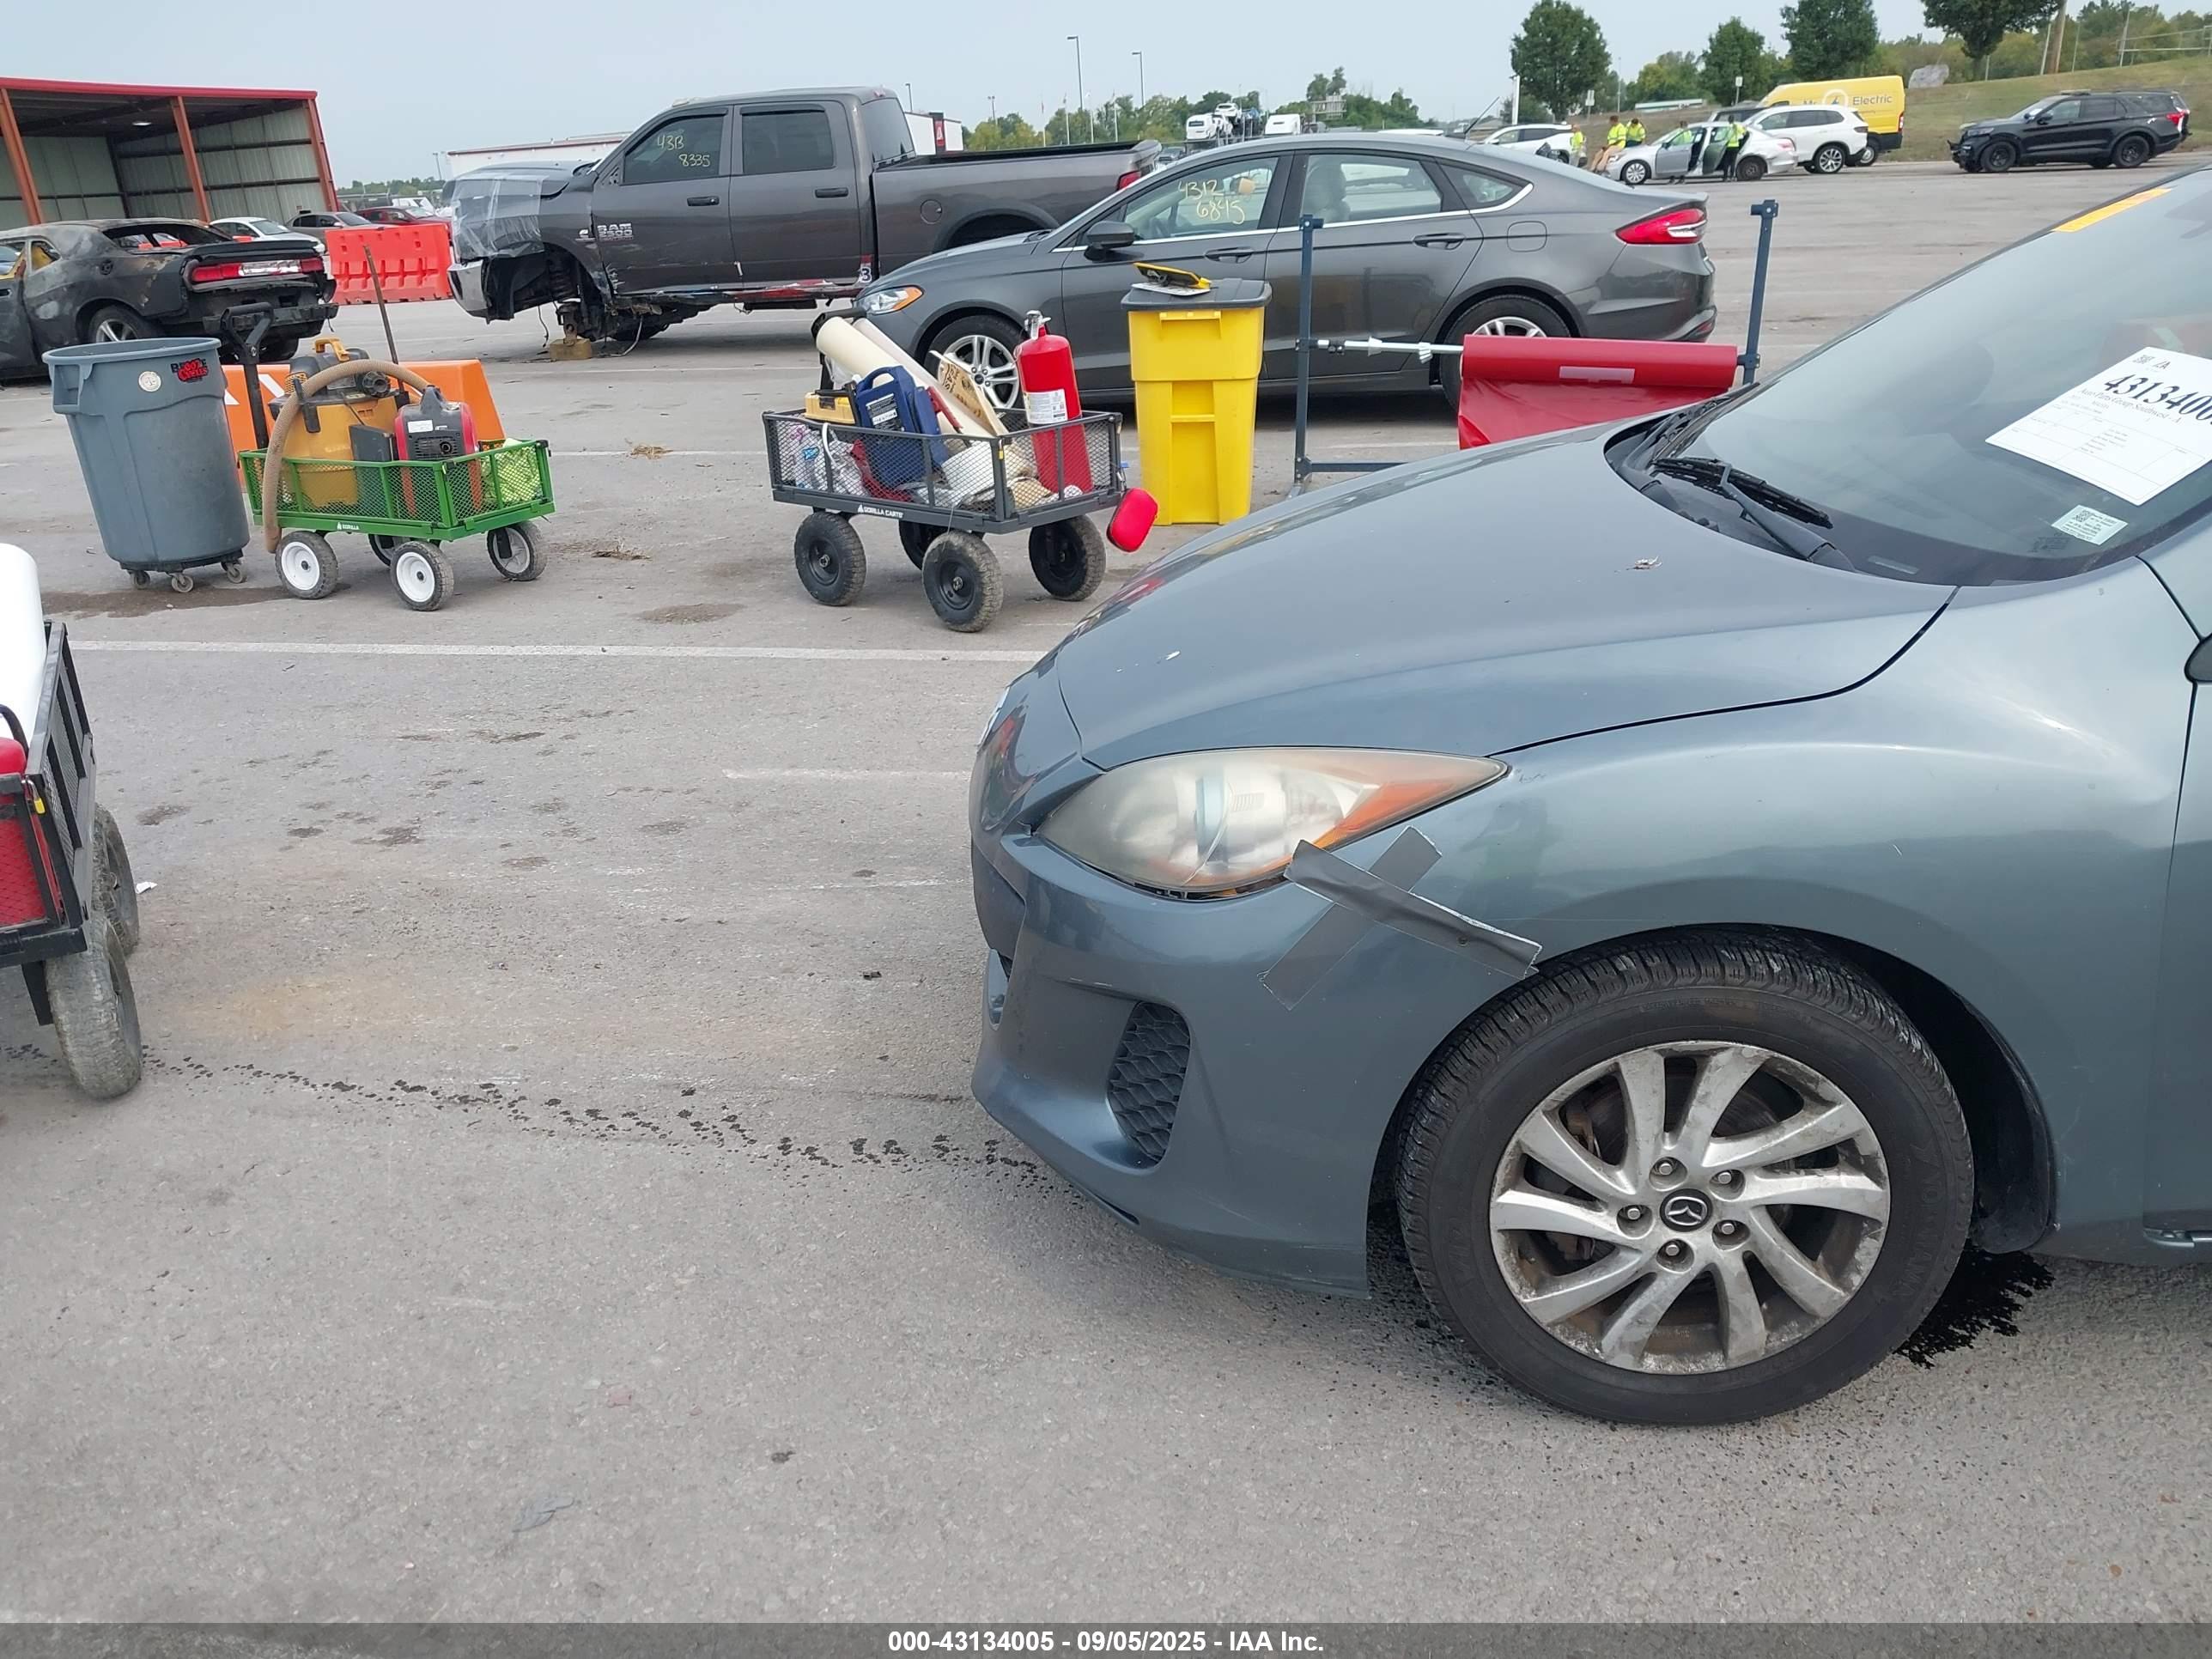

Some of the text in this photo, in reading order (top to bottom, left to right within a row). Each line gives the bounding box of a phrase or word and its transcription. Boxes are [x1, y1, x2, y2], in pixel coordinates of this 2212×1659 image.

[1852, 94, 1893, 106] Electric
[678, 154, 711, 167] 8335
[1177, 179, 1224, 200] 4312
[1196, 199, 1245, 225] 6845
[597, 223, 632, 232] RAM
[599, 229, 633, 238] 2500
[2105, 374, 2212, 425] 4313400
[863, 507, 903, 519] GORILLA CARTS
